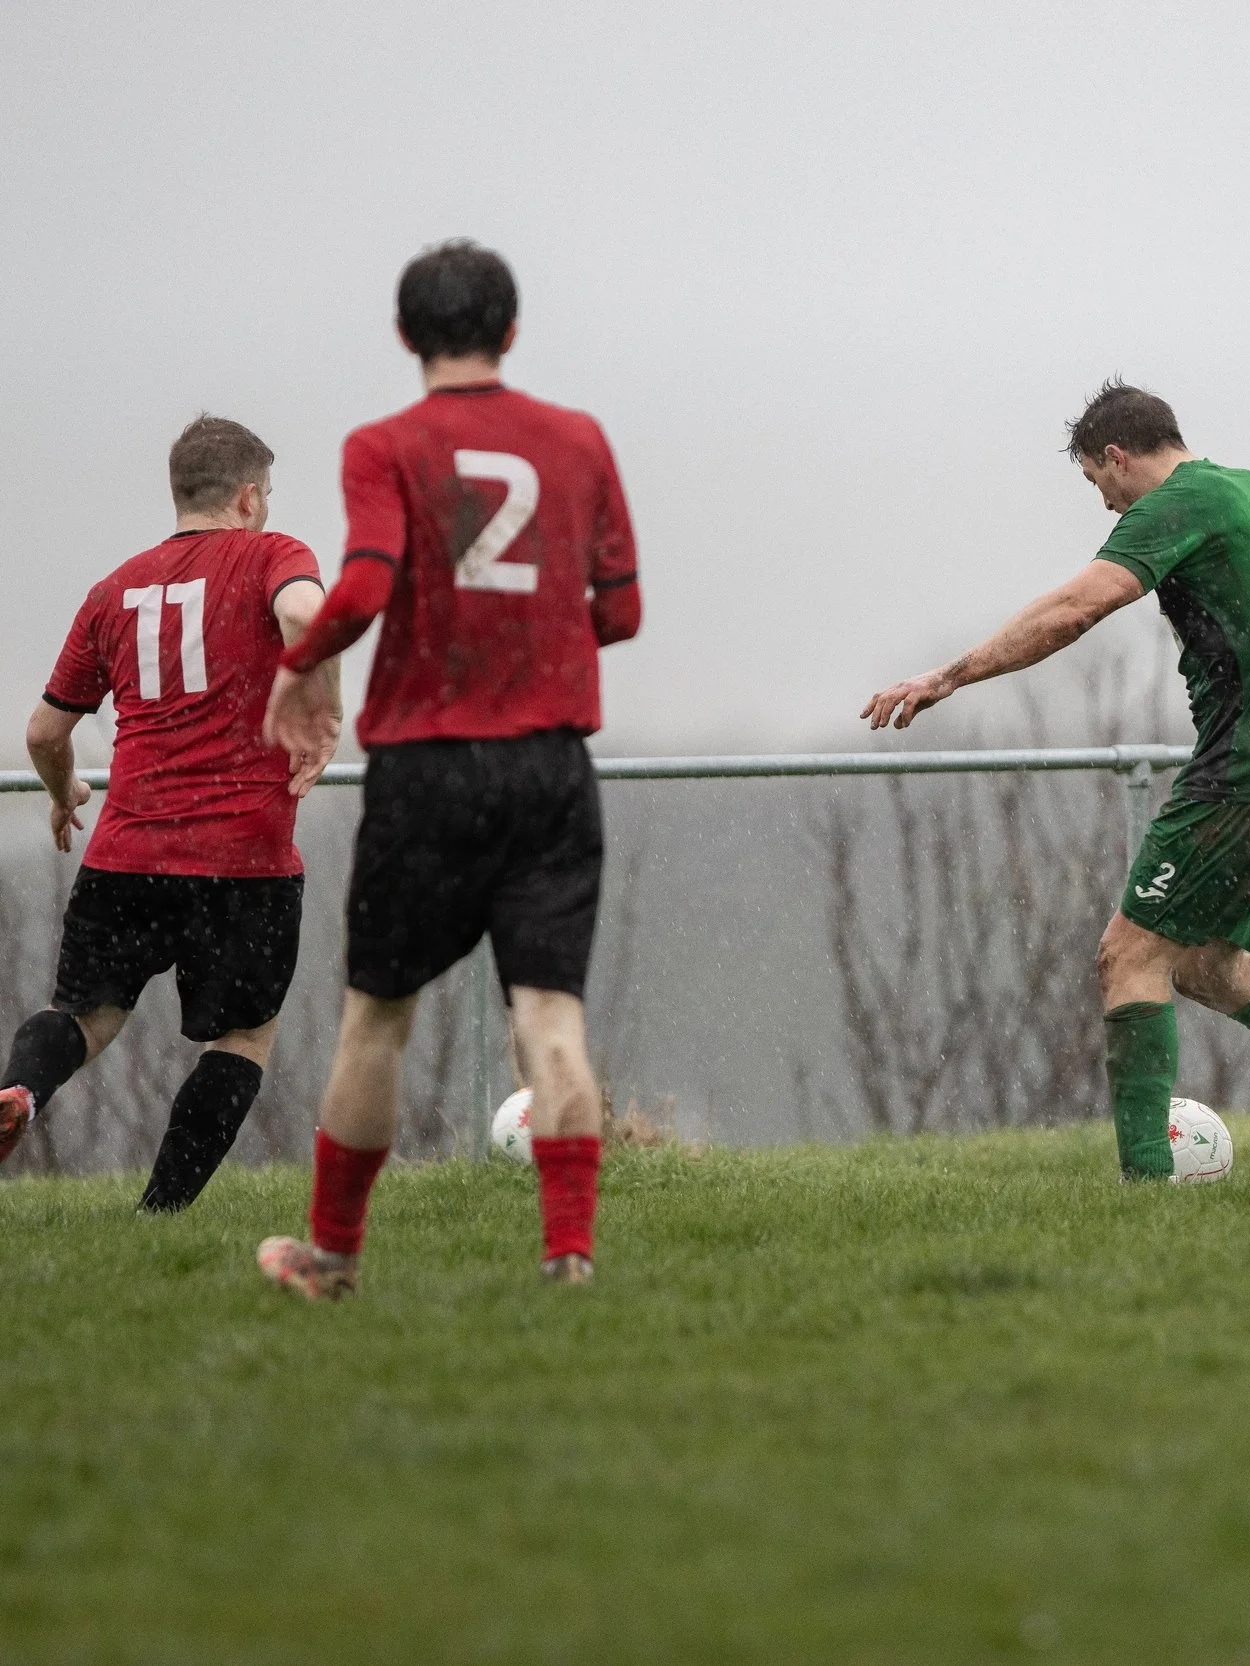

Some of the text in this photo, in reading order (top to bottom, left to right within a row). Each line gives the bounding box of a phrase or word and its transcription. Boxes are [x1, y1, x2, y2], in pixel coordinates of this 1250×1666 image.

[454, 449, 540, 593] 2
[123, 578, 208, 699] 11
[1152, 862, 1176, 890] 2
